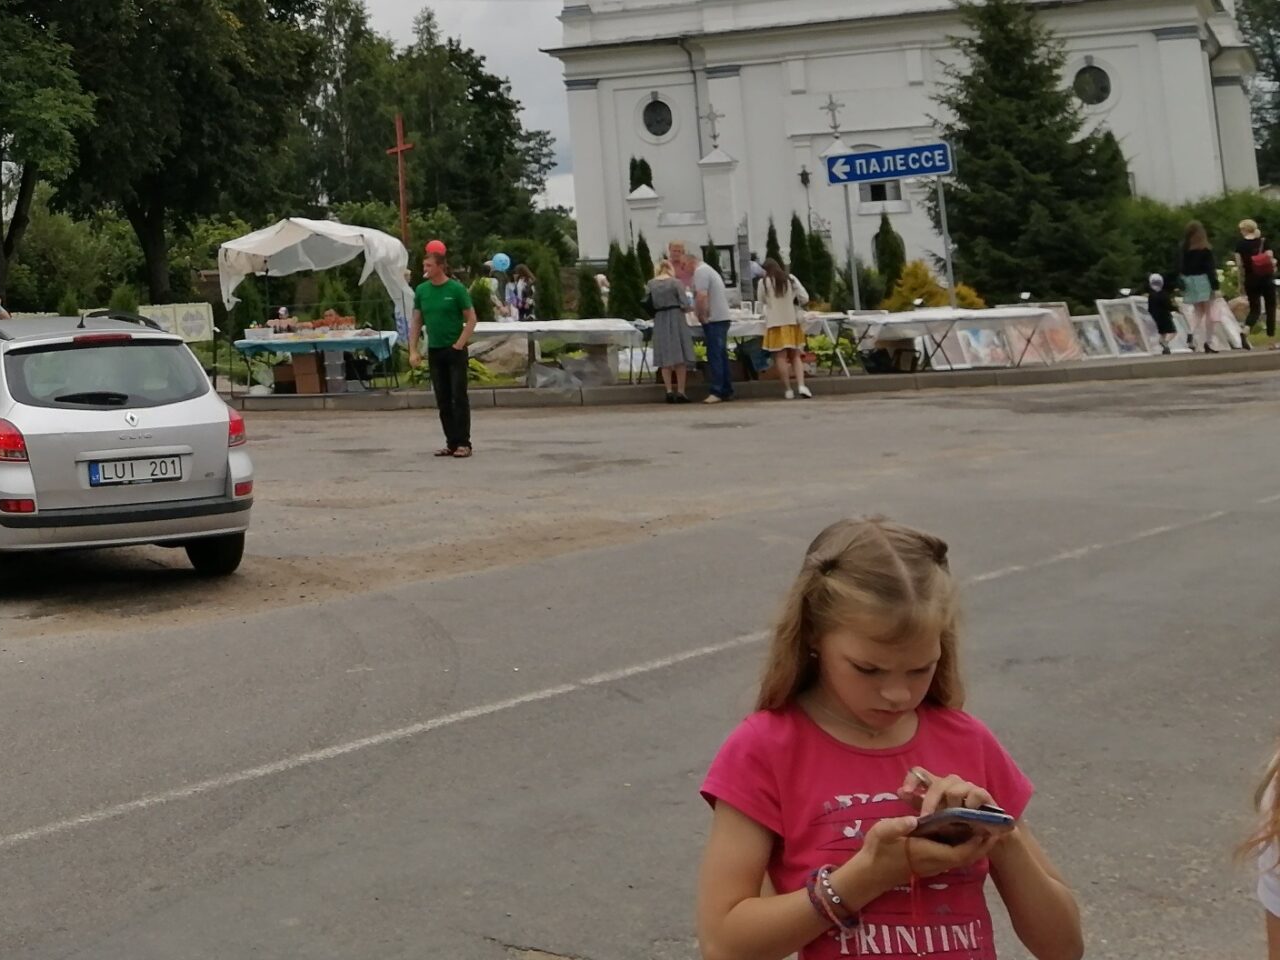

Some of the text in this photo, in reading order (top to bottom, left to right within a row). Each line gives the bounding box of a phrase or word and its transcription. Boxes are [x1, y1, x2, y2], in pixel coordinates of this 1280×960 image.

[855, 150, 946, 175] ПАЛЕССЕ
[102, 459, 177, 480] LUI 201
